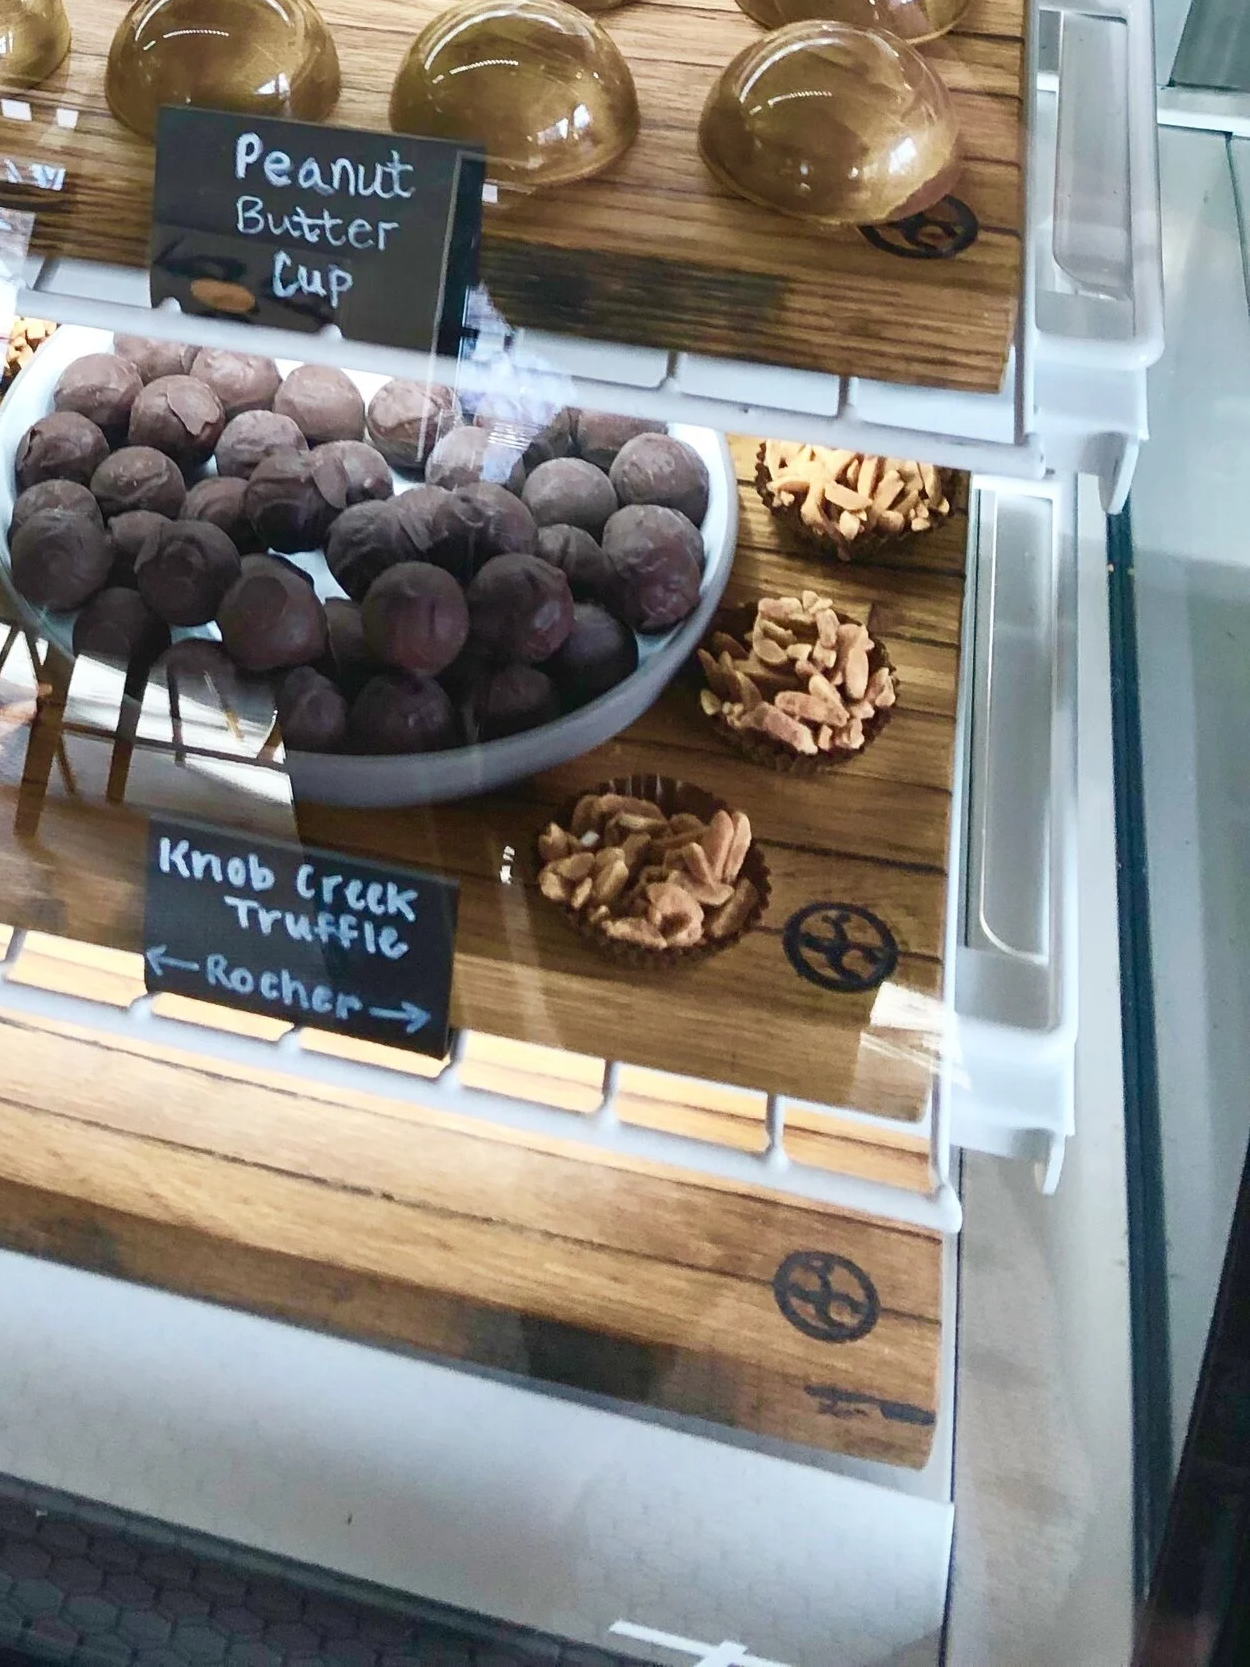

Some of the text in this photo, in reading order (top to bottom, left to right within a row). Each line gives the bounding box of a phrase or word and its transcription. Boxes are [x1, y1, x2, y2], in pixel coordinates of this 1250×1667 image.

[234, 131, 416, 200] Peanut
[235, 195, 400, 252] Butter
[272, 249, 354, 310] Cup
[158, 836, 419, 923] Knob Creek
[223, 894, 410, 960] Truffle
[205, 953, 364, 1021] Rocher
